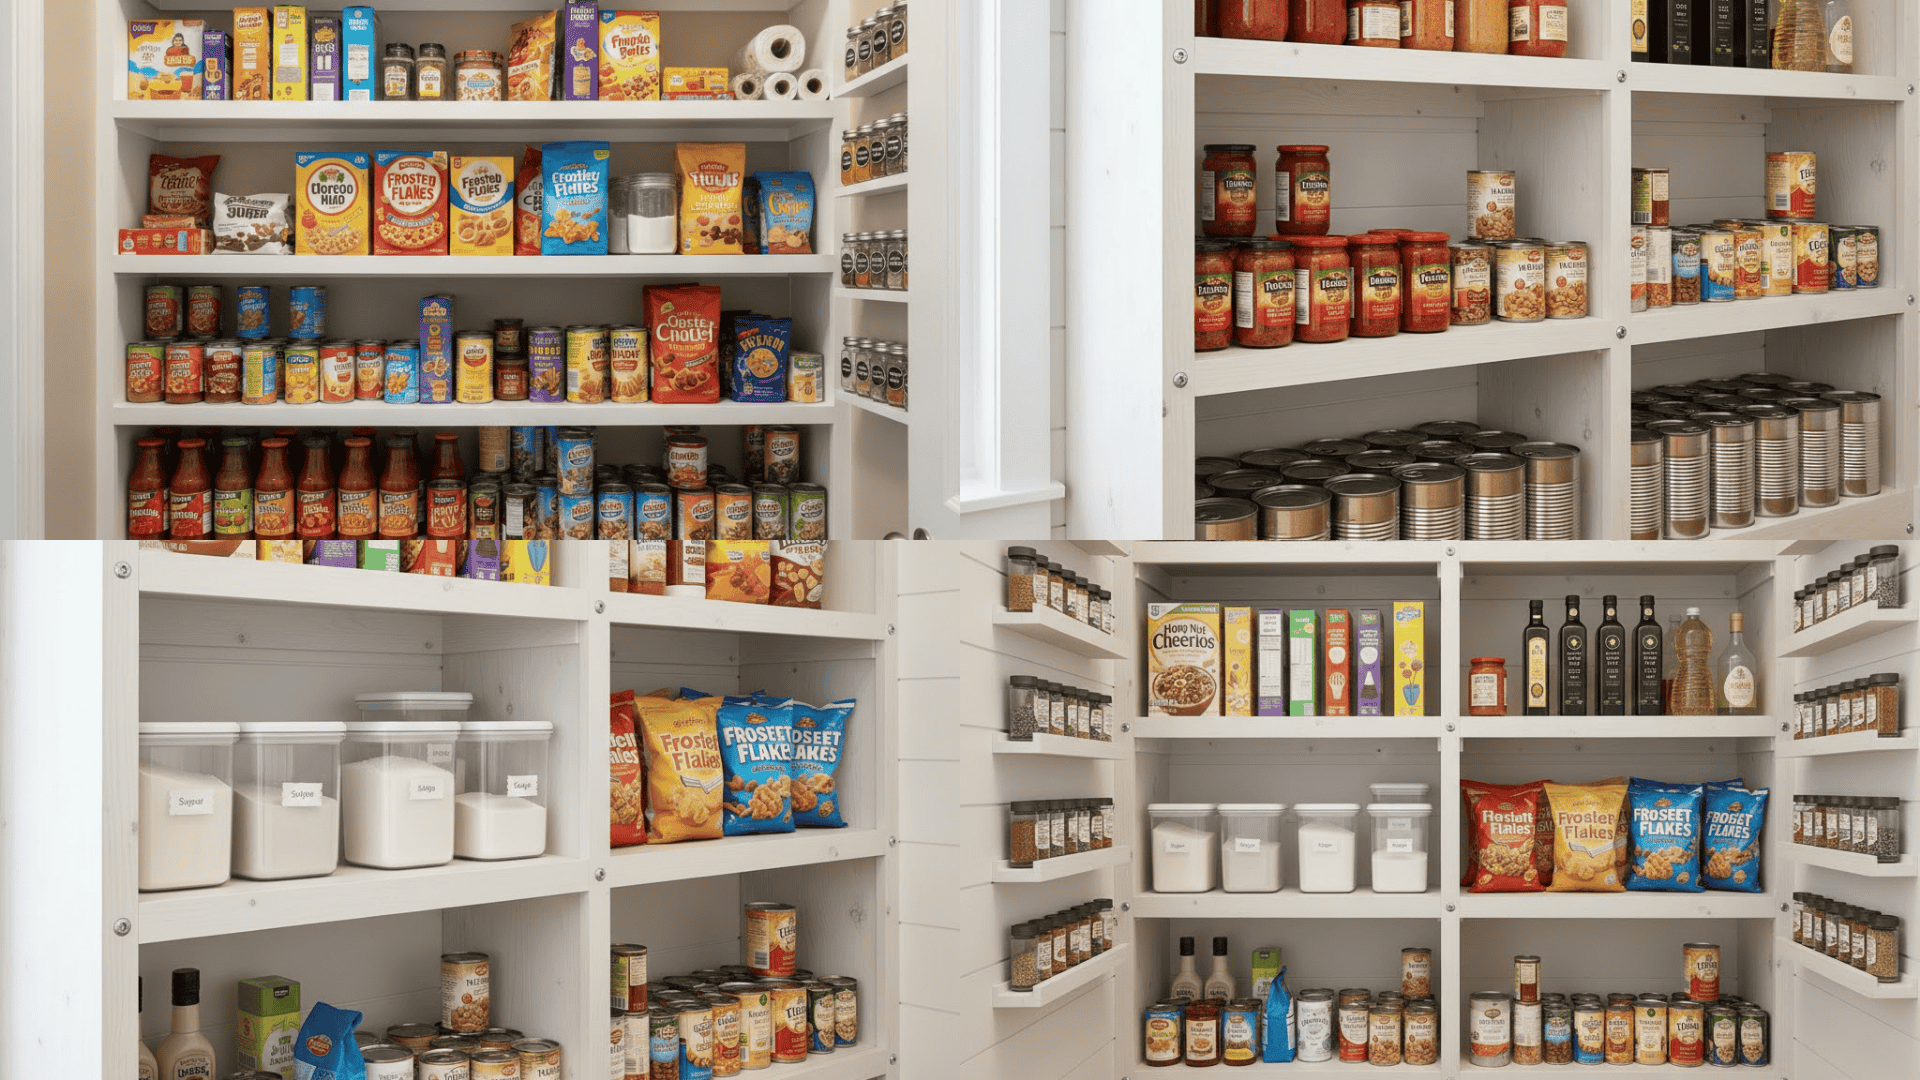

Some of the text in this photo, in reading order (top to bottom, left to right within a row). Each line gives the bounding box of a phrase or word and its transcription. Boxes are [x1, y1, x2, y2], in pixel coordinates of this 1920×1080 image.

[387, 173, 436, 189] FROSTED
[392, 184, 434, 201] FLAKES
[1152, 633, 1215, 650] Cheerios
[1633, 808, 1693, 822] FROSEET
[1639, 821, 1693, 838] FLAKES
